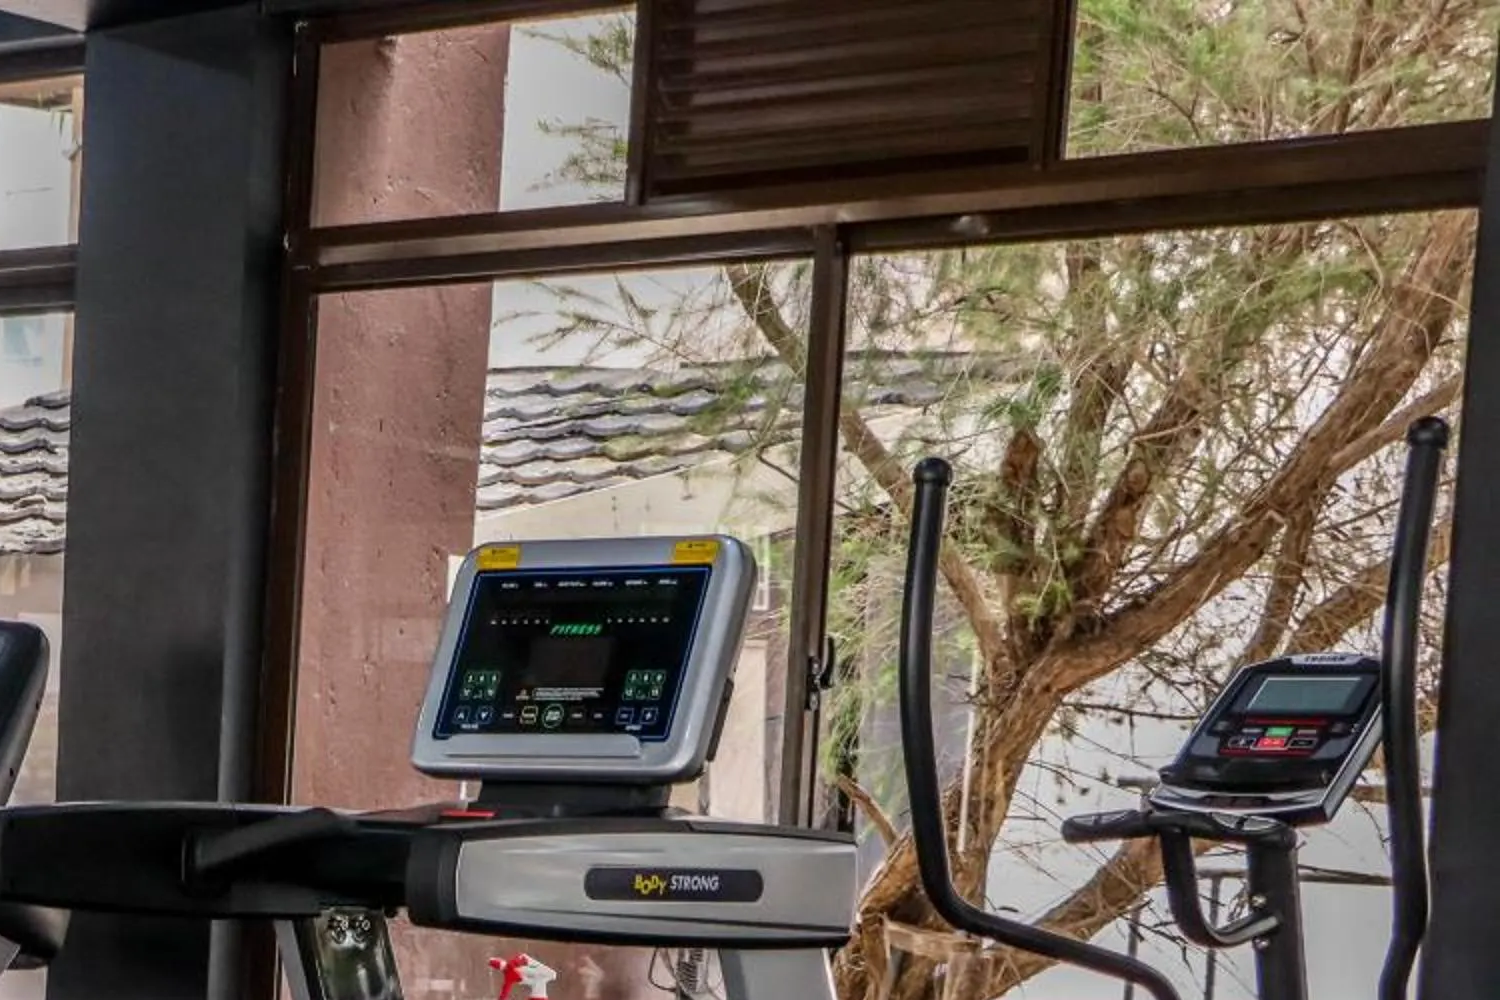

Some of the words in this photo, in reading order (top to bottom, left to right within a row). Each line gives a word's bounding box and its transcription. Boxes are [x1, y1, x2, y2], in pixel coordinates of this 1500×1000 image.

[550, 623, 602, 636] FITNESS
[634, 874, 666, 895] BODY
[670, 875, 719, 891] STRONG
